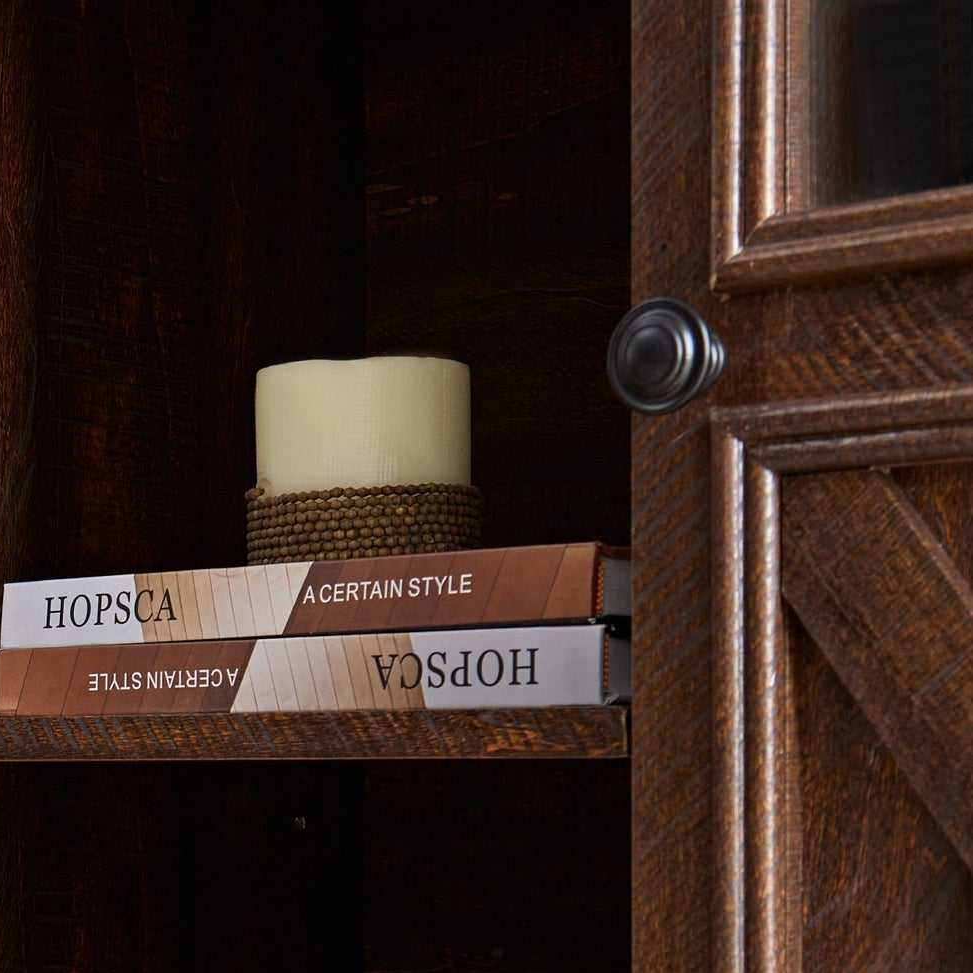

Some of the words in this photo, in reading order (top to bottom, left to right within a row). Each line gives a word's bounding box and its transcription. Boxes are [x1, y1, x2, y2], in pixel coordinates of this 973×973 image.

[302, 585, 316, 604] A
[319, 579, 403, 603] CERTAIN
[408, 573, 473, 597] STYLE
[43, 588, 177, 629] HOPSCA
[88, 671, 142, 691] STYLE
[147, 668, 223, 689] CERTAIN
[226, 668, 239, 686] A
[371, 648, 539, 690] HOPSCA
